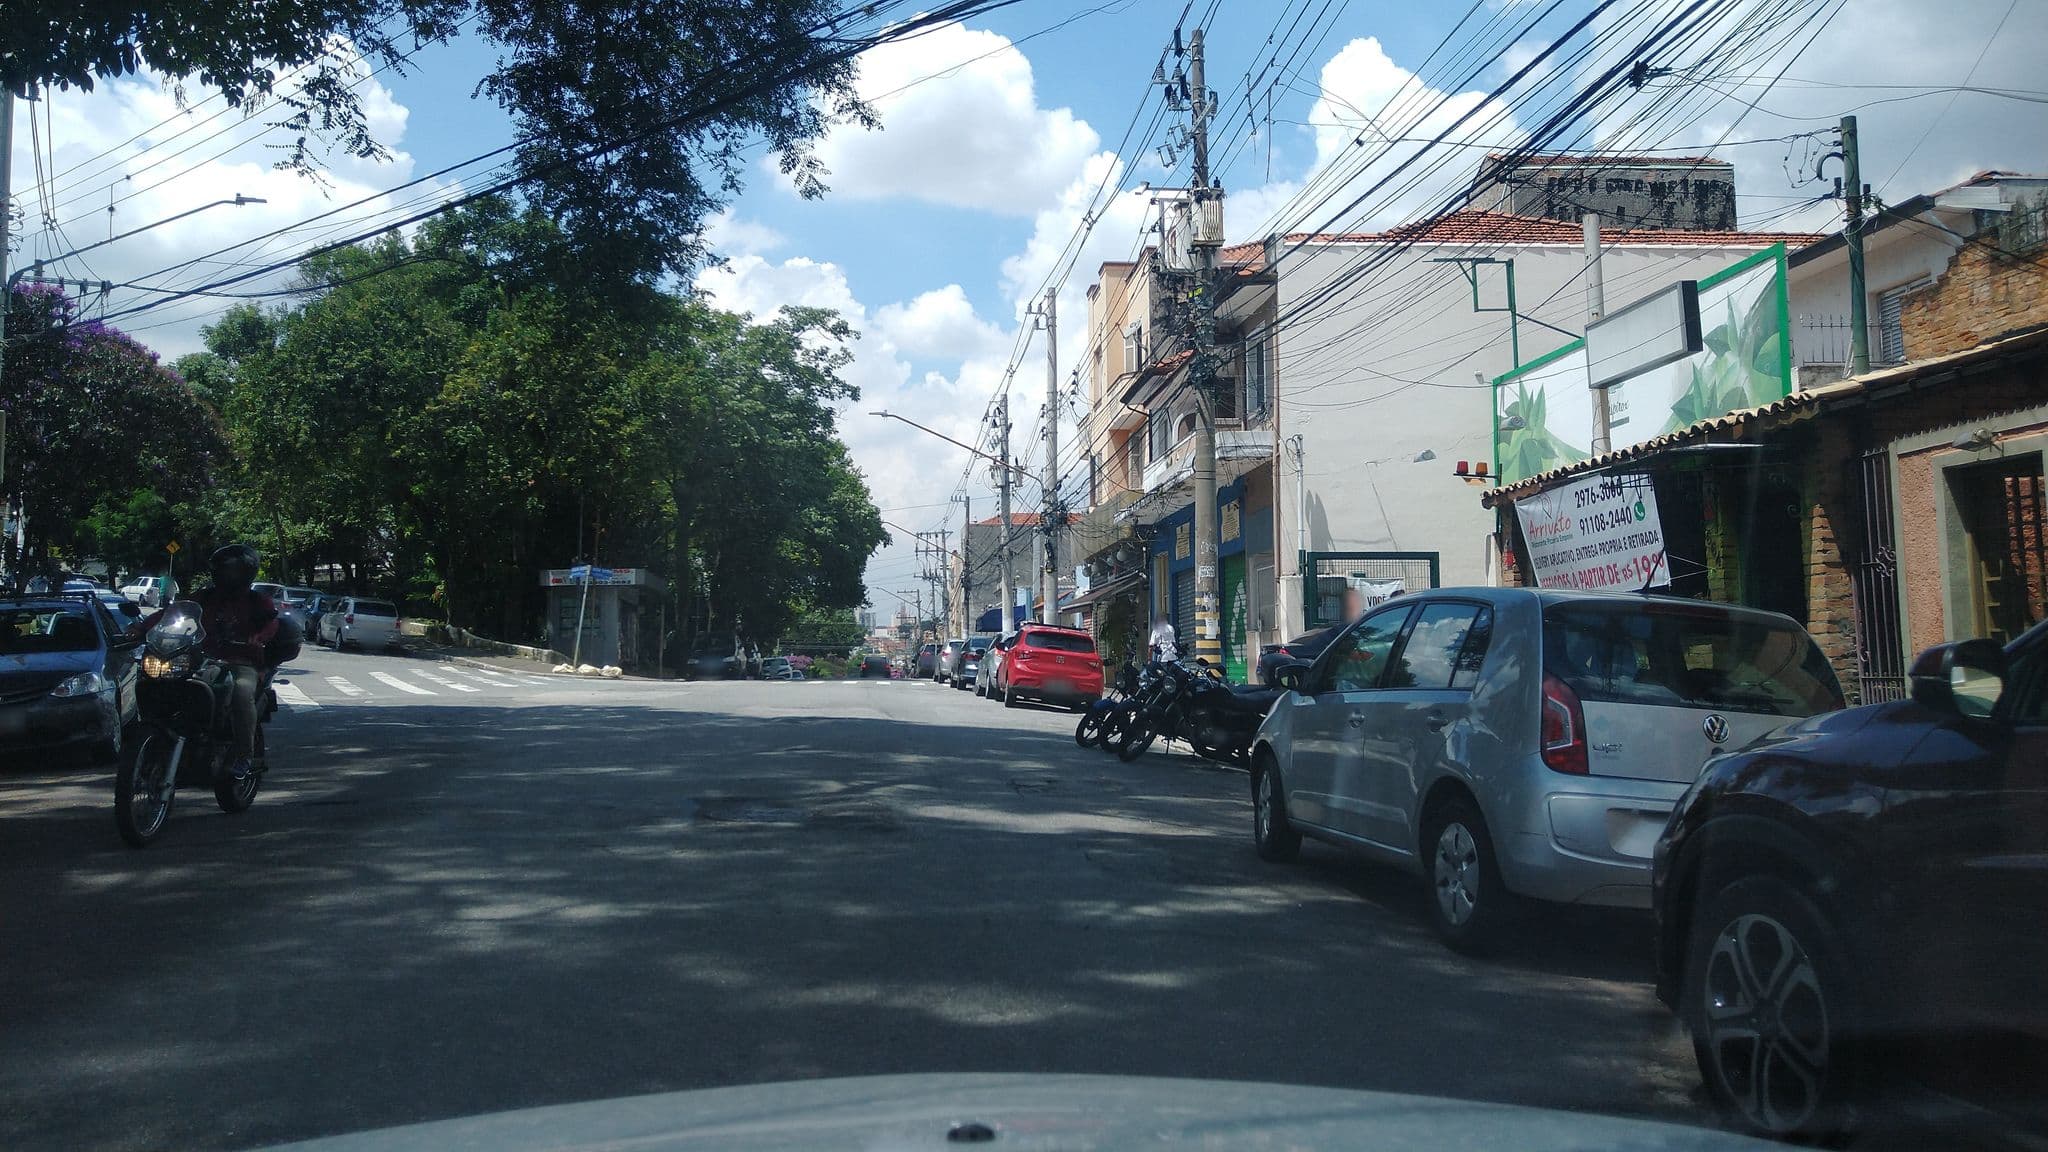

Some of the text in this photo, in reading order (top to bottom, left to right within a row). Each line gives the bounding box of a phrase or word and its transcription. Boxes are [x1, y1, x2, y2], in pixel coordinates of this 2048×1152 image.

[1529, 511, 1571, 539] Arrivato
[1580, 506, 1632, 536] 91108-2440
[1622, 536, 1628, 550] E
[1628, 530, 1660, 549] RETIRADA
[1578, 566, 1608, 590] PARTIR
[1606, 564, 1621, 585] DE
[1621, 563, 1633, 582] R$
